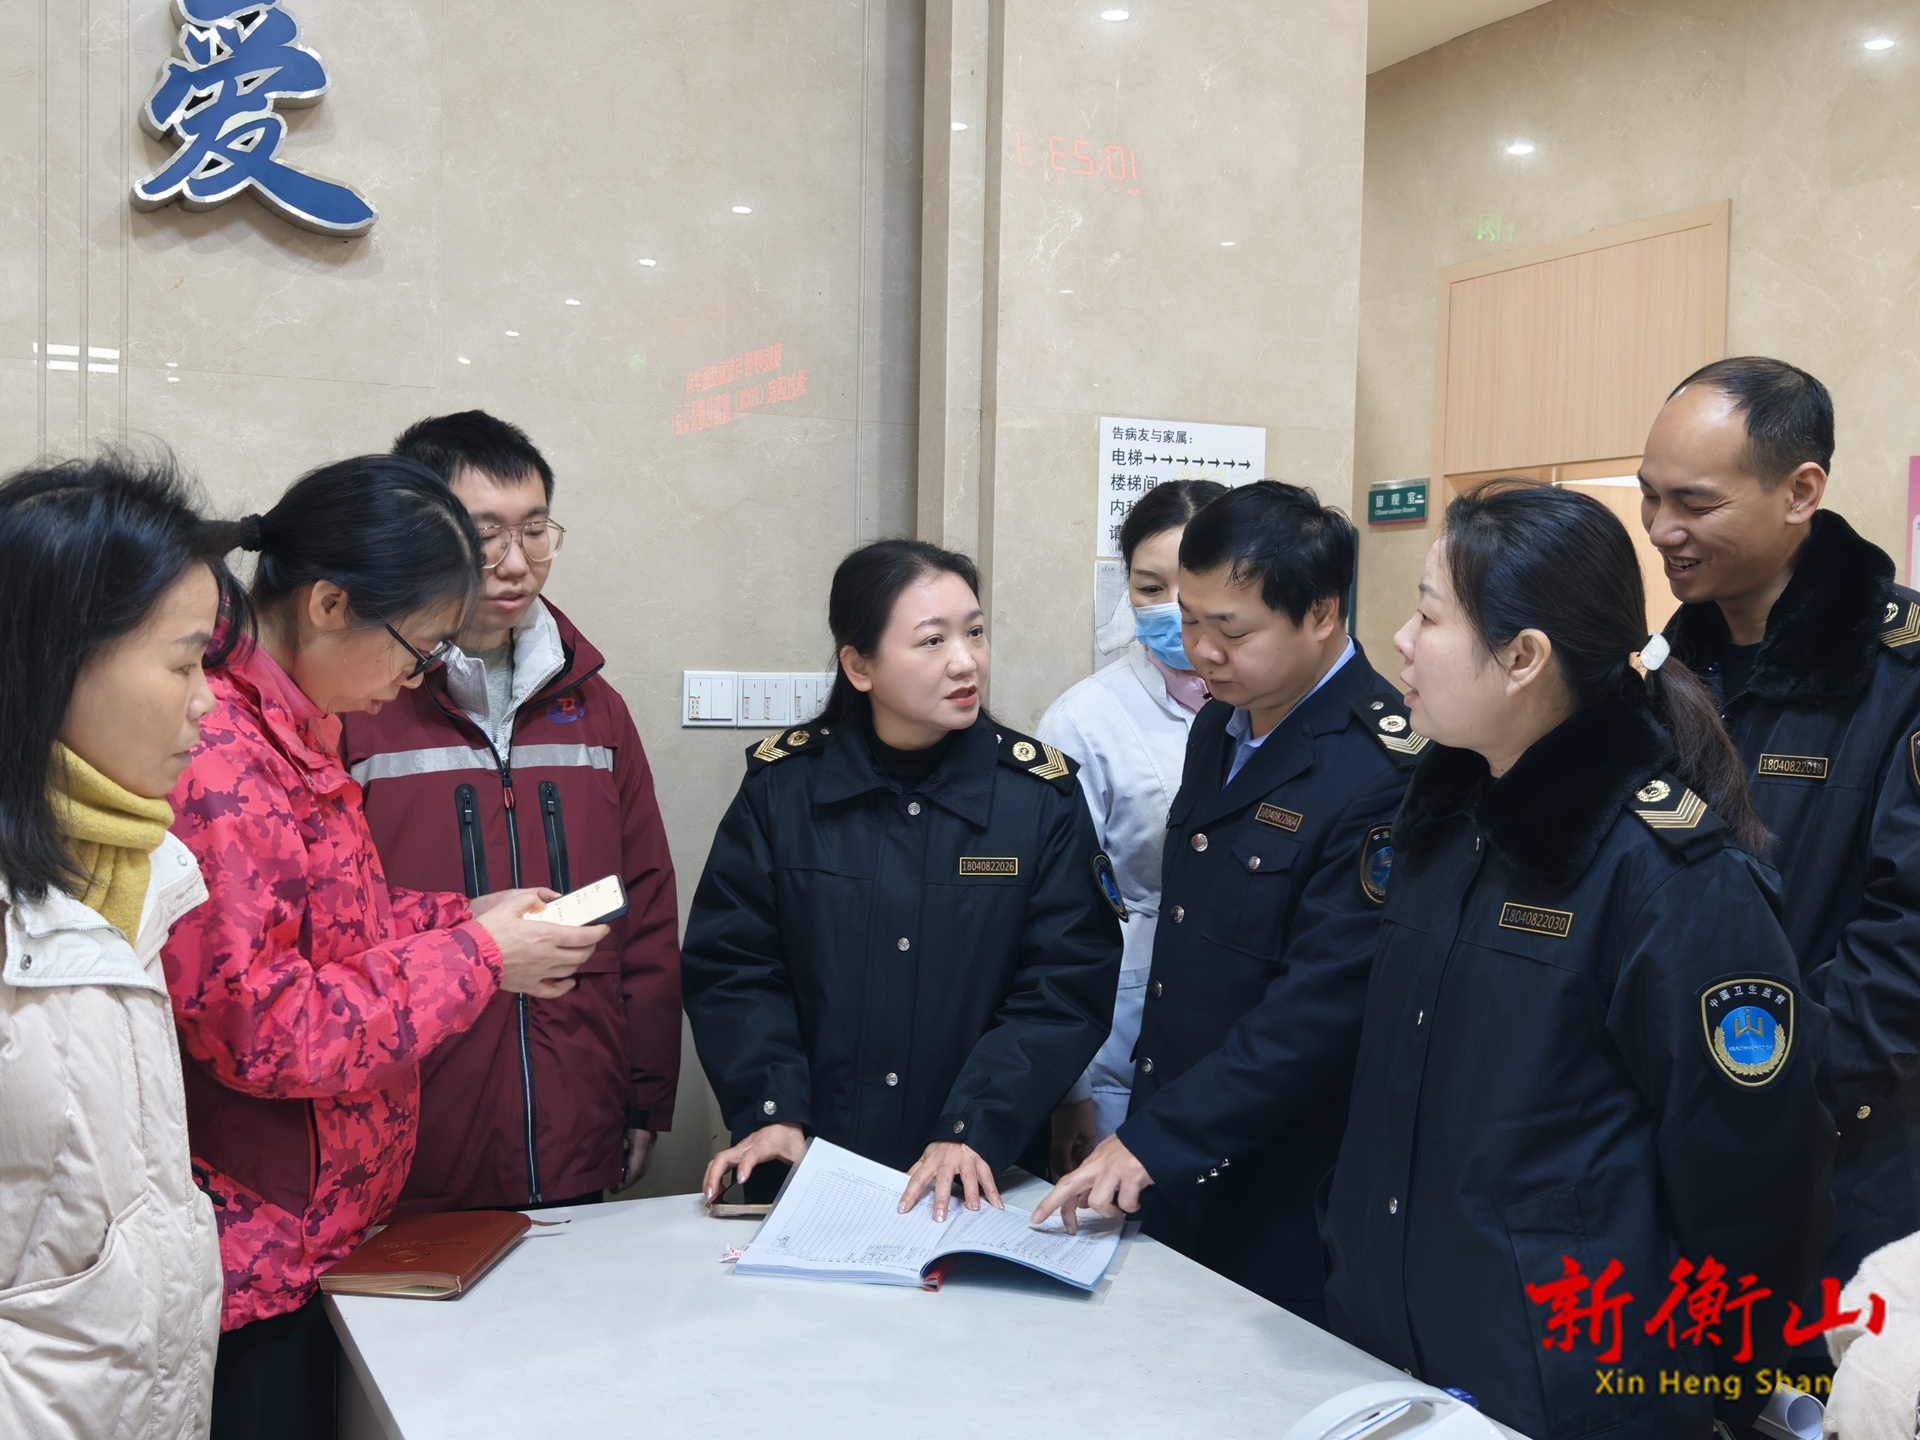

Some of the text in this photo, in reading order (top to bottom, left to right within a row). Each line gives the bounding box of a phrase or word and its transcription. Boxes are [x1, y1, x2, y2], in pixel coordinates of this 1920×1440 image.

[130, 0, 378, 236] 爱
[1112, 426, 1193, 445] 告病友与家属：
[1111, 448, 1143, 466] 电梯
[1110, 473, 1158, 493] 楼梯间
[962, 861, 1015, 871] 18040822026
[1503, 908, 1567, 931] 18040822030
[1709, 984, 1787, 1008] 中国卫生监督
